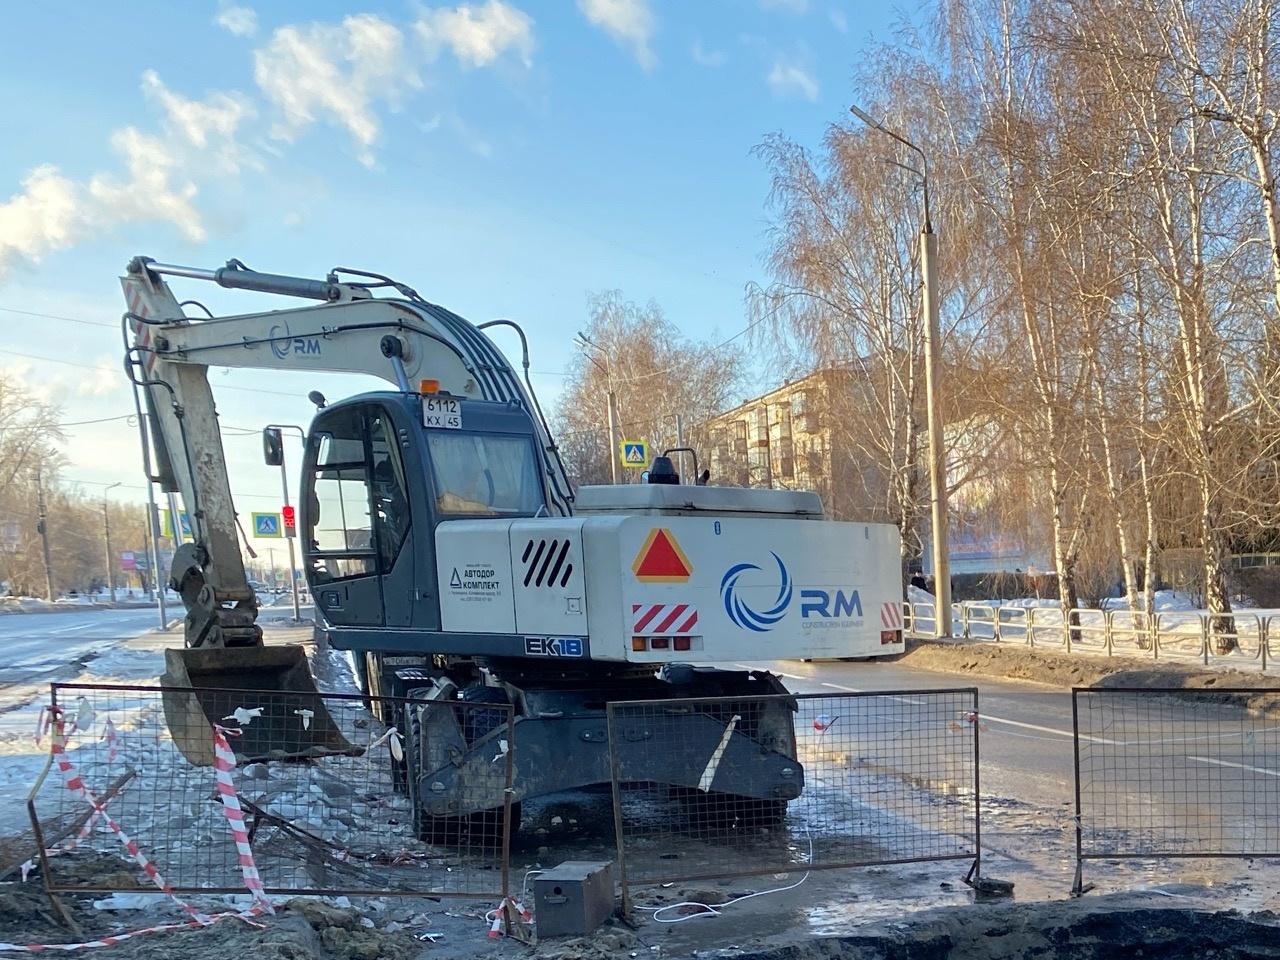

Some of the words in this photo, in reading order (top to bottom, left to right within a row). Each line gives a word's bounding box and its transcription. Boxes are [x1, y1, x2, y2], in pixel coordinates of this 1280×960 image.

[294, 339, 321, 354] RM
[427, 399, 457, 414] 6112
[447, 416, 459, 427] 45
[464, 569, 495, 579] АВТОДОР
[463, 581, 500, 589] КОМПЛЕКТ
[801, 590, 863, 617] RM
